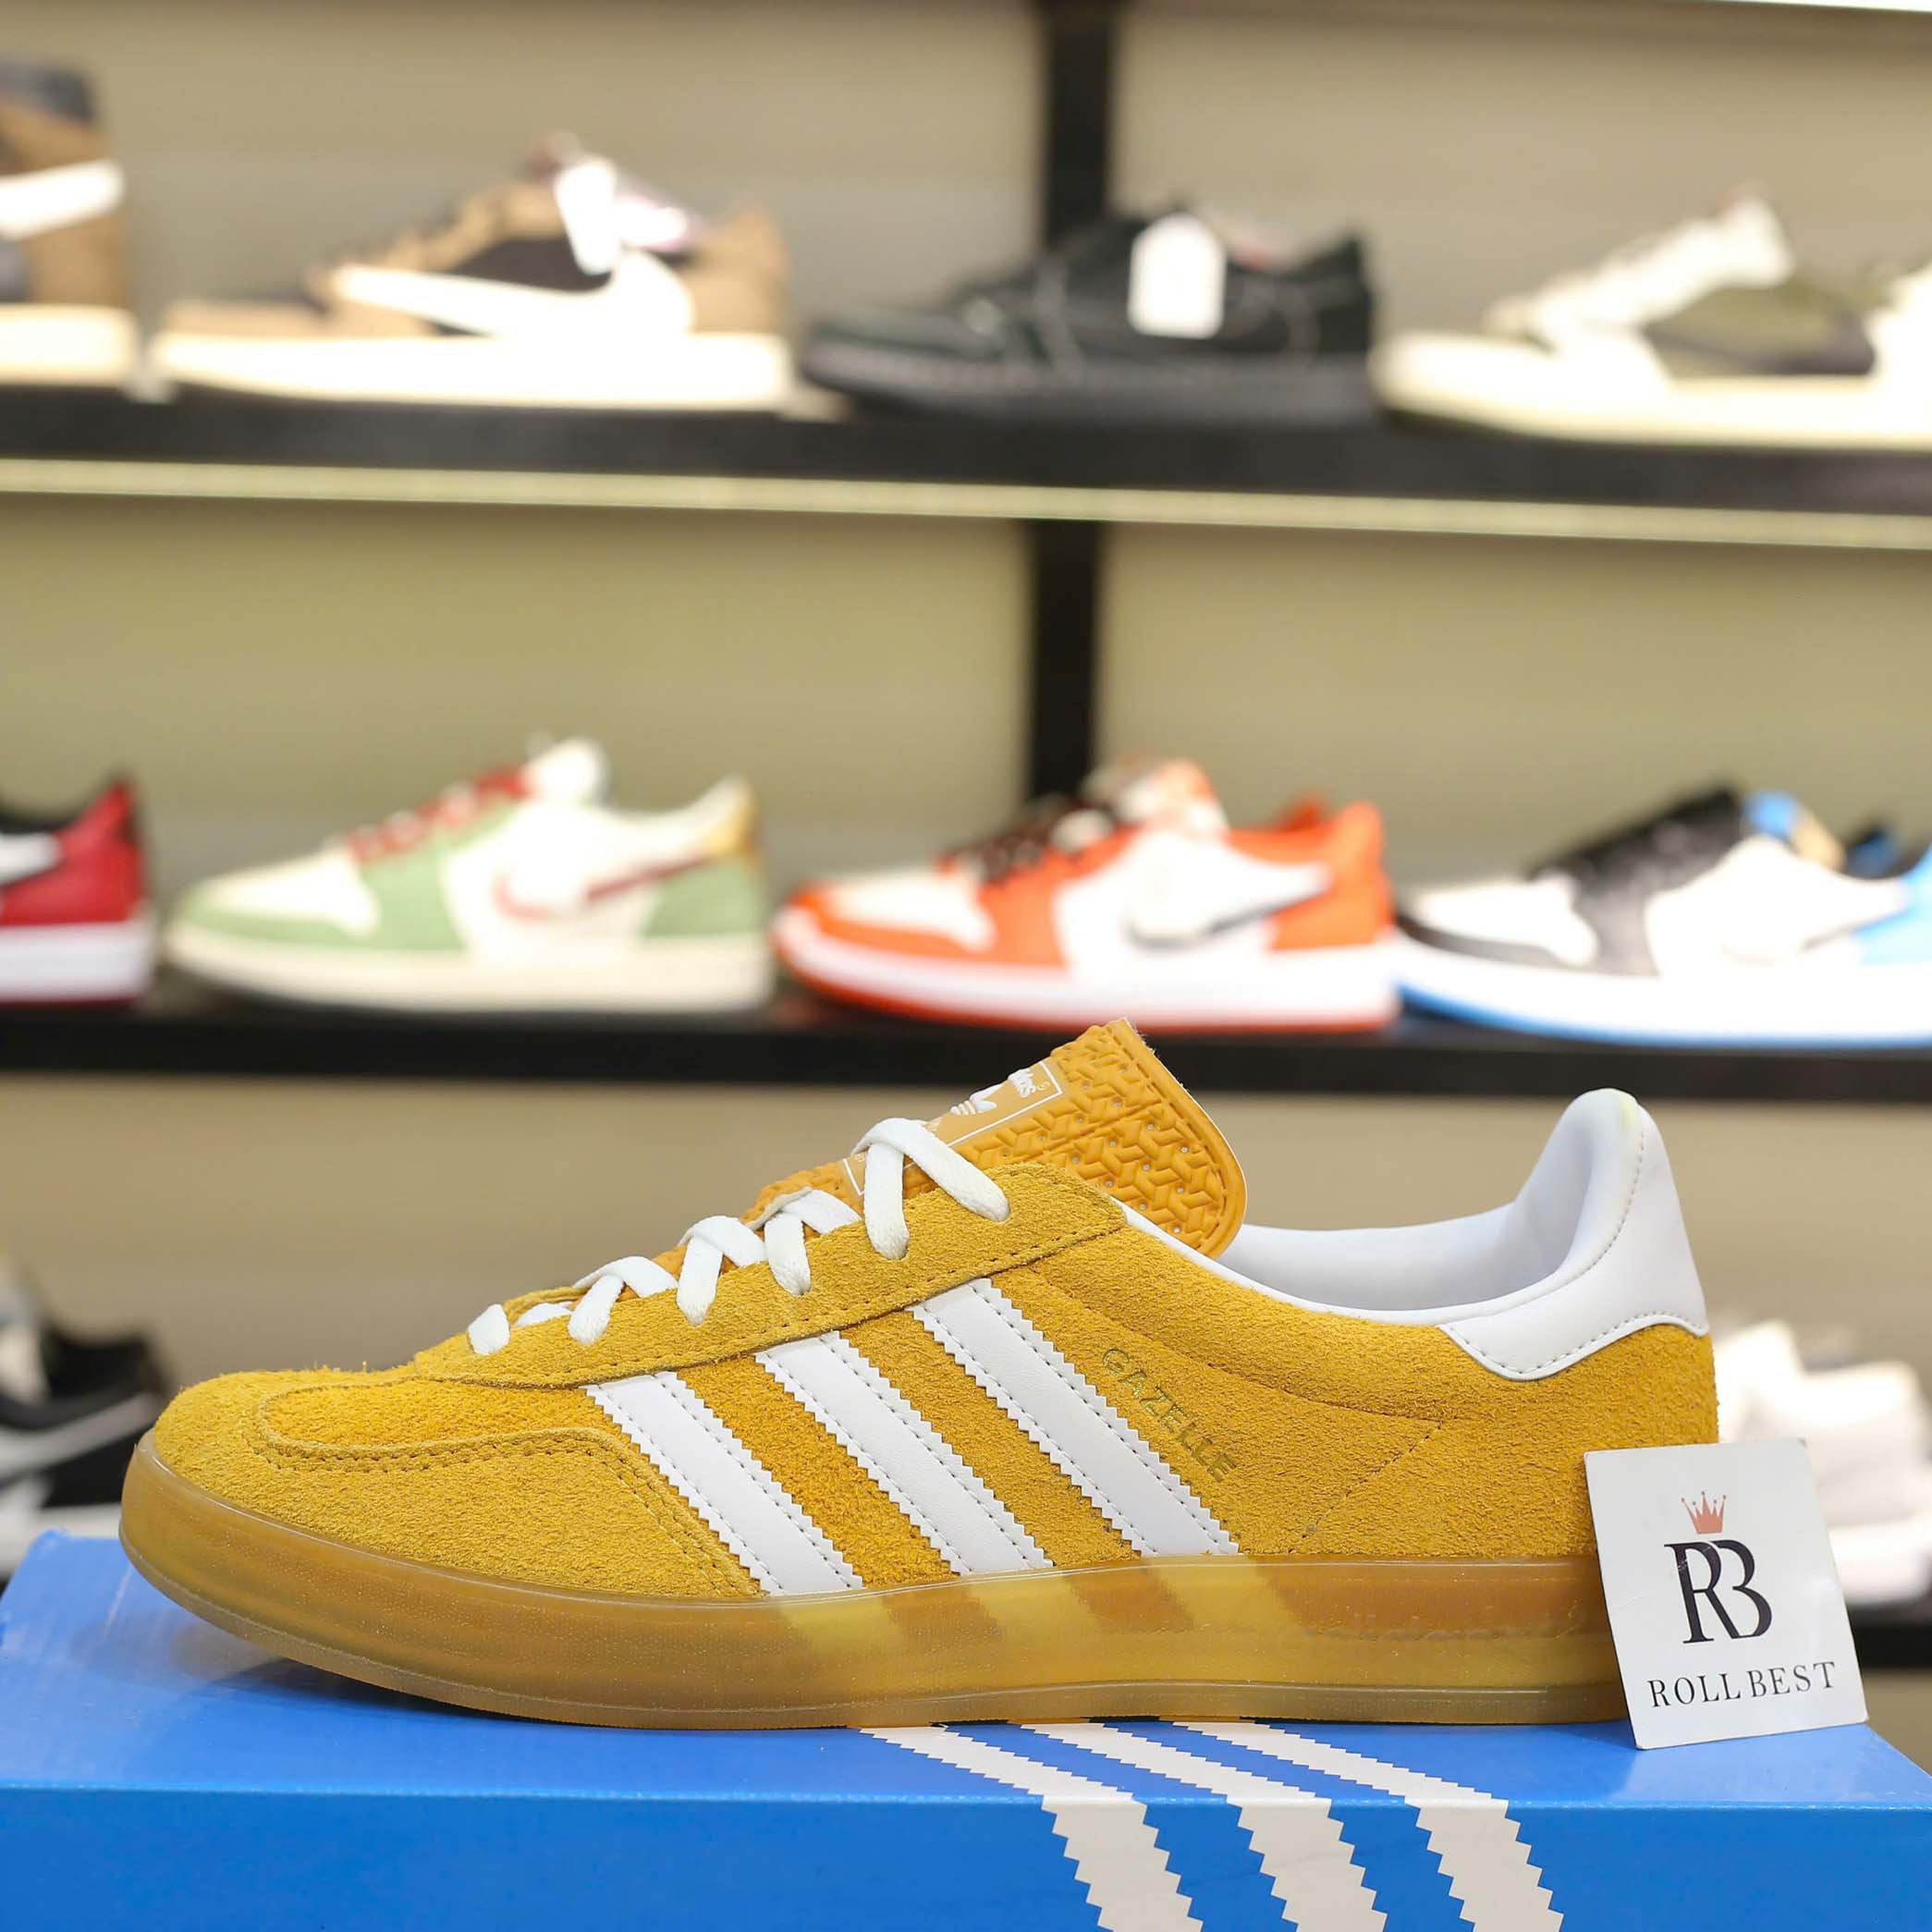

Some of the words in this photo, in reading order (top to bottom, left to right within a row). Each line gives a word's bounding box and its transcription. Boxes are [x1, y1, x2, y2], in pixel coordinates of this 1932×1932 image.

[1103, 1348, 1237, 1482] GAZELLE
[1646, 1672, 1742, 1707] ROLL
[1746, 1661, 1836, 1698] BEST
